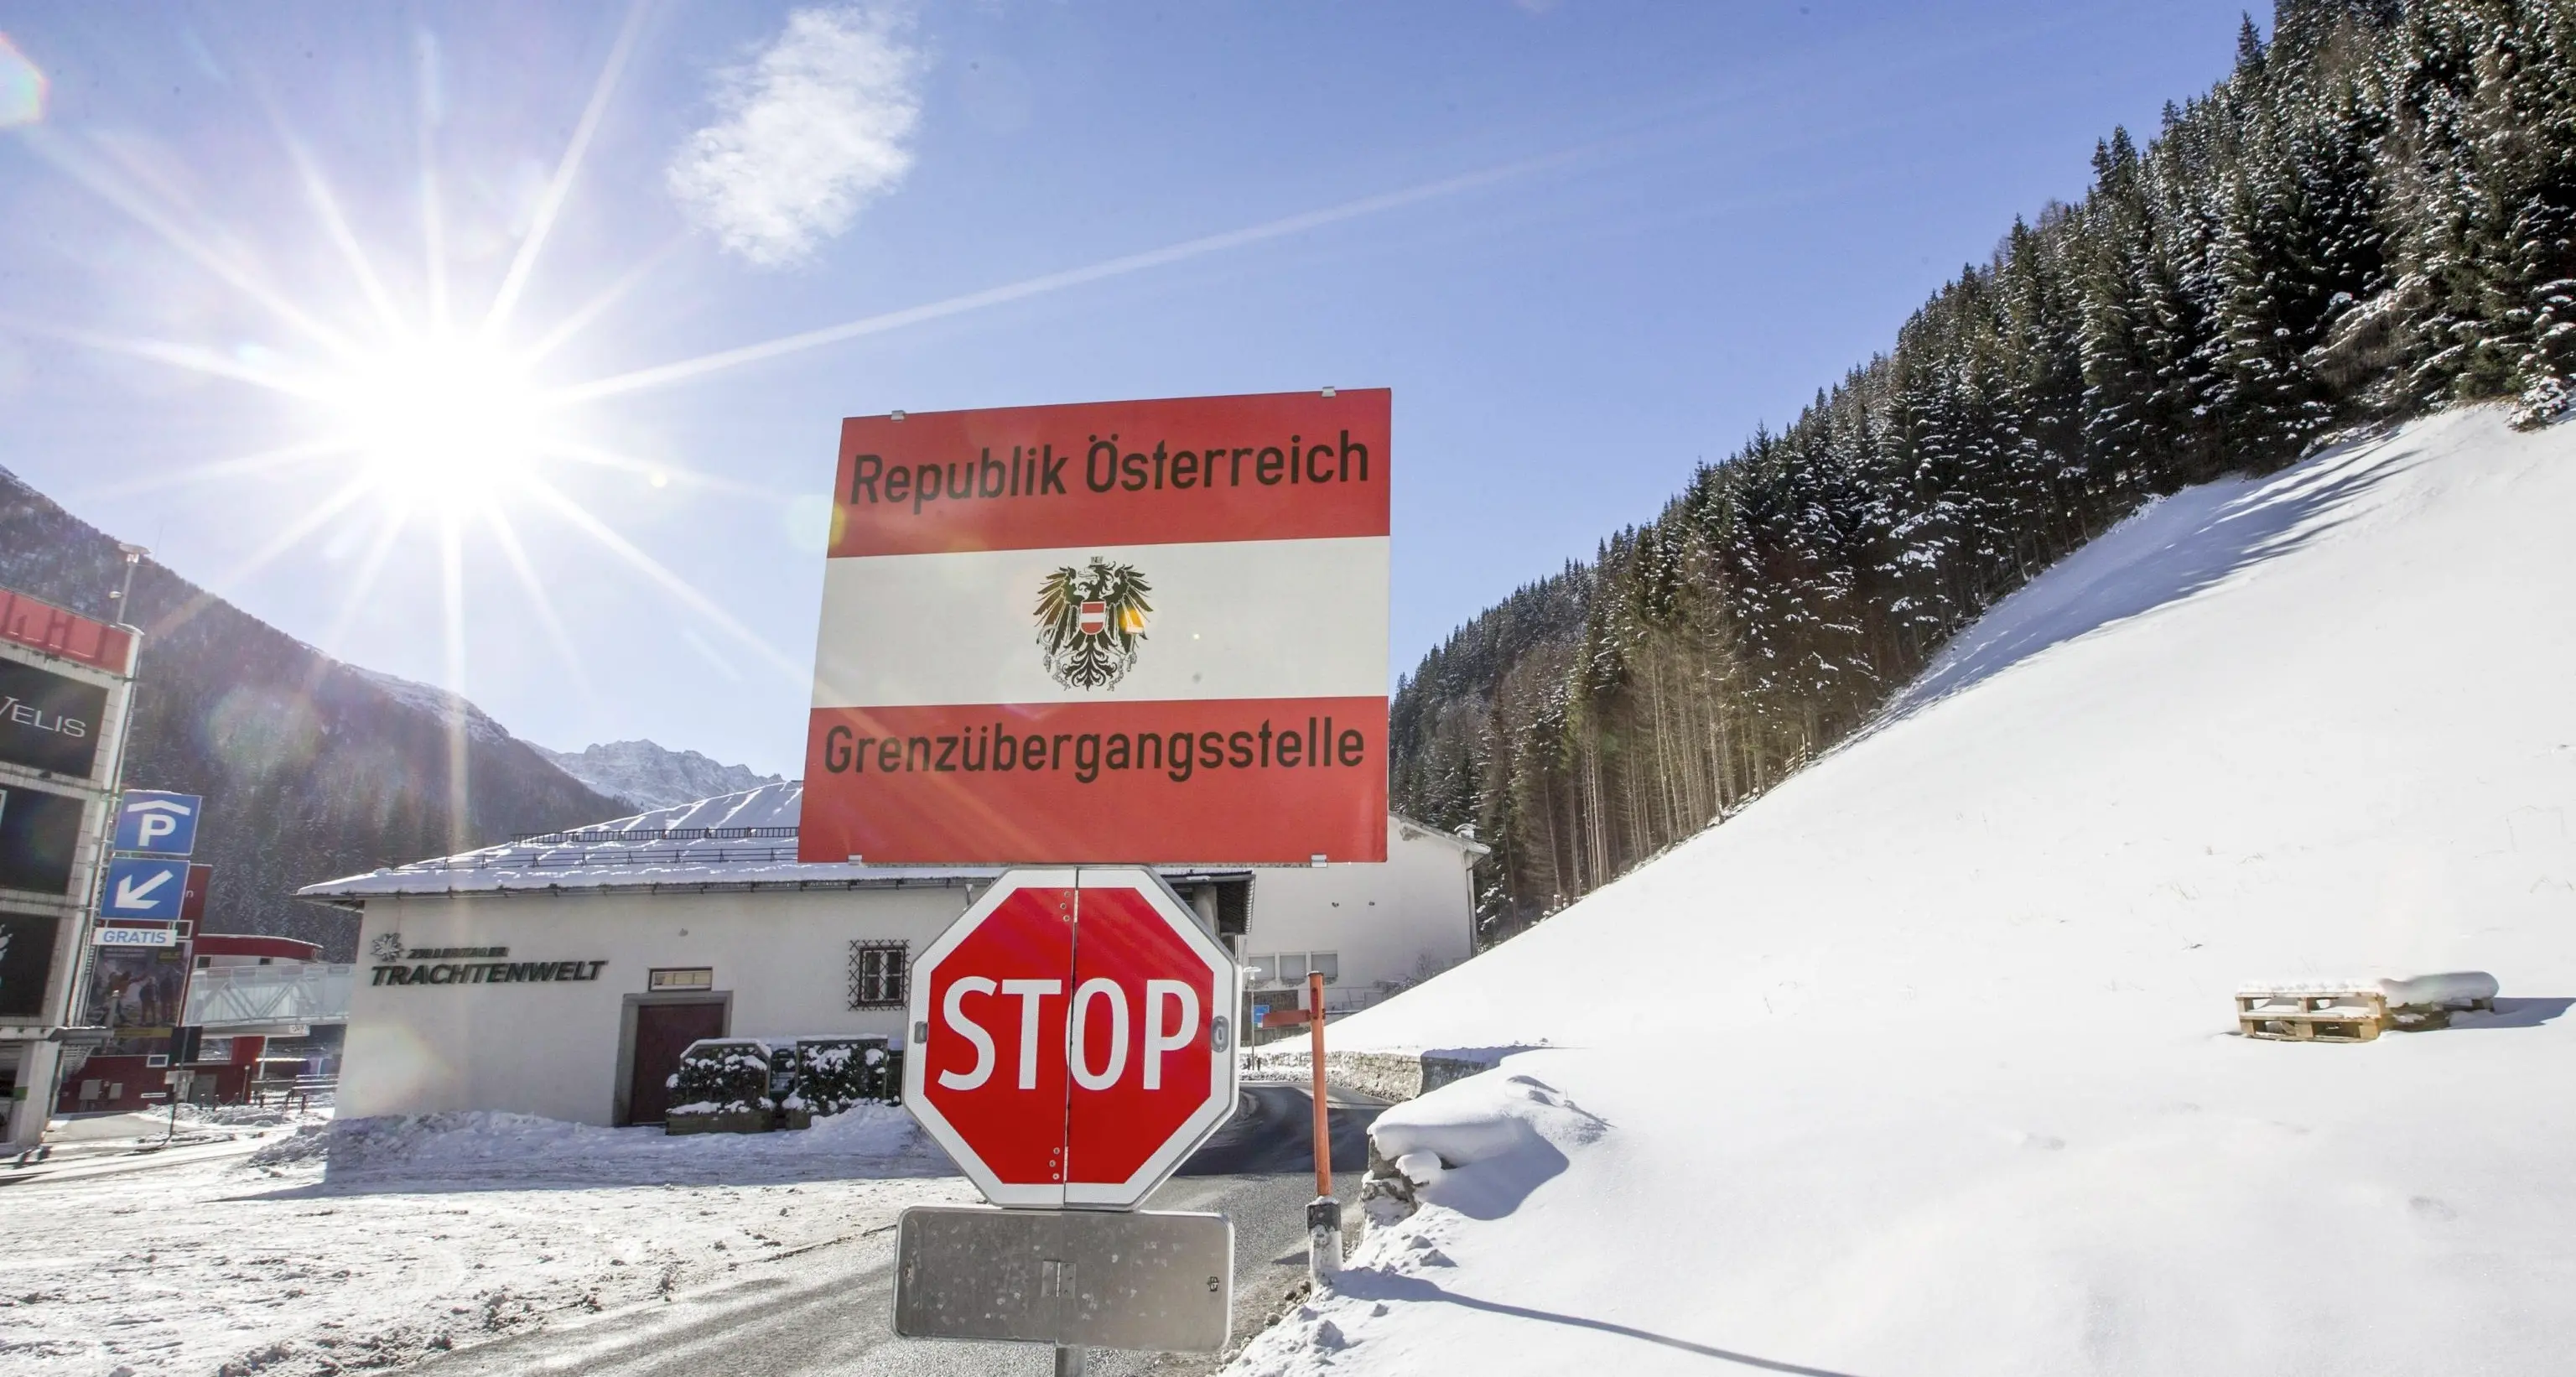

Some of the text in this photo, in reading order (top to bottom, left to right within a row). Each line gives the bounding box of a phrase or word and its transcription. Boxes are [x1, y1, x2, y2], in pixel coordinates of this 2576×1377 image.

[850, 430, 1369, 515] Republik Österreich
[825, 717, 1365, 782] Grenzübergangsstelle
[138, 813, 176, 846] P
[103, 930, 167, 943] GRATIS
[371, 960, 609, 986] TRACHTENWELT
[937, 975, 1199, 1090] STOP
